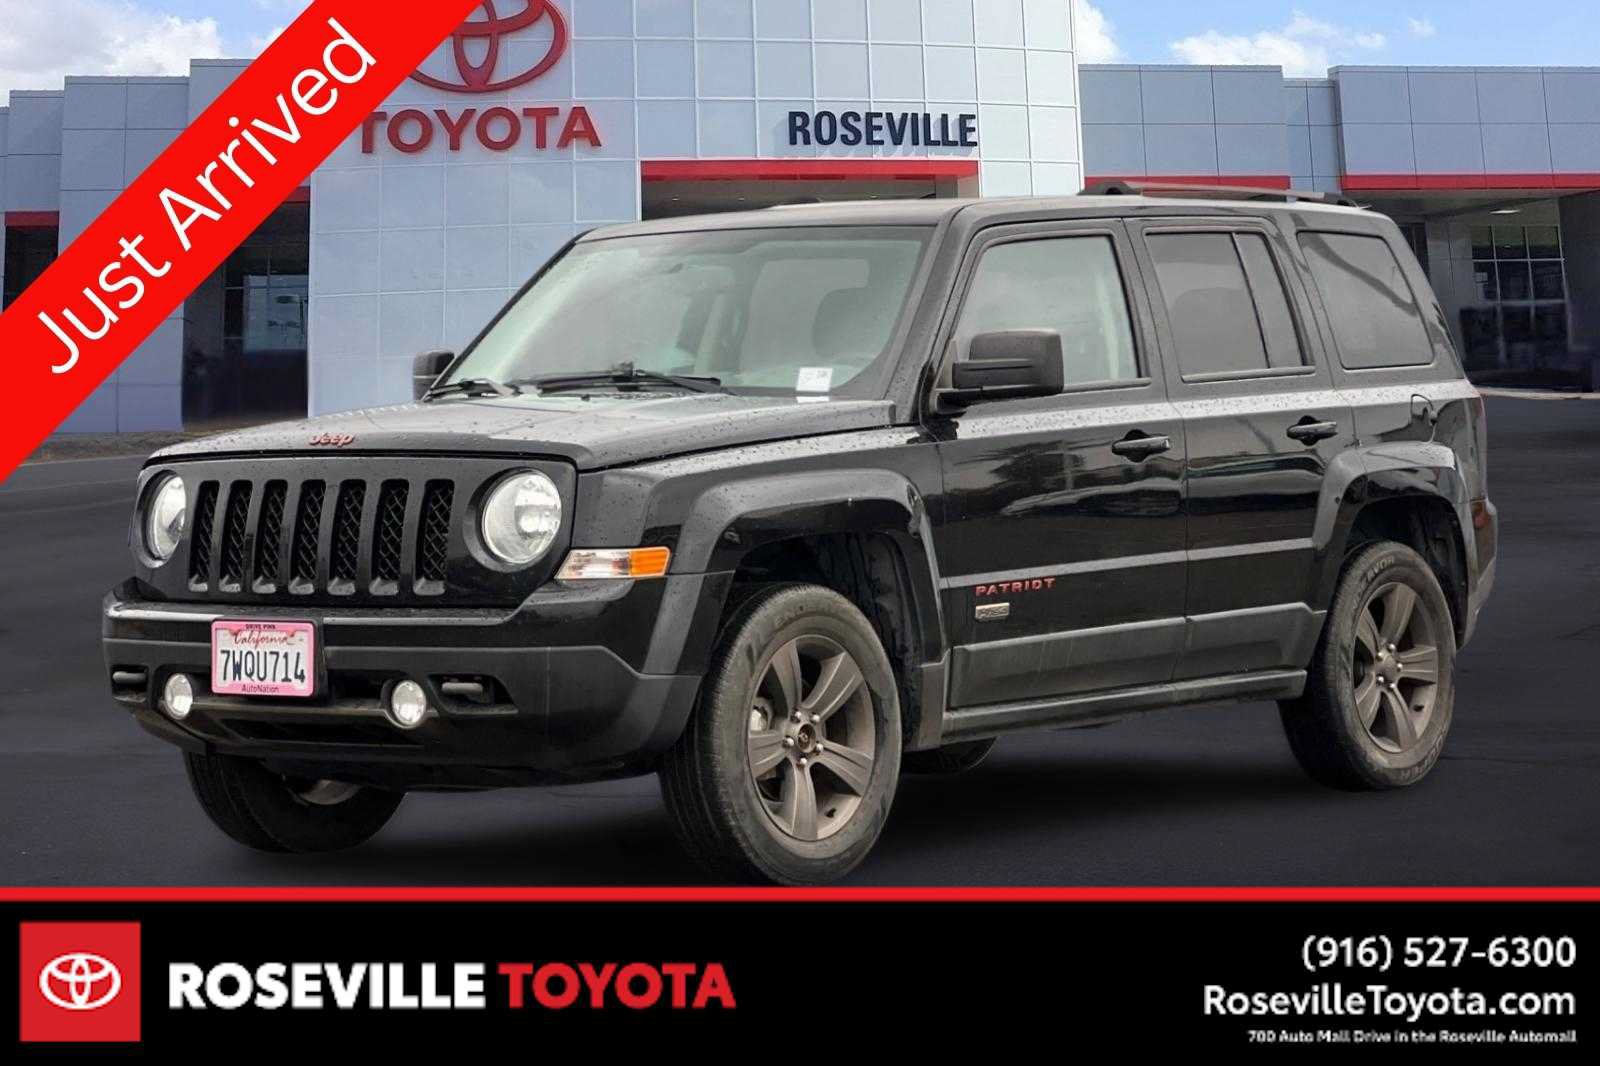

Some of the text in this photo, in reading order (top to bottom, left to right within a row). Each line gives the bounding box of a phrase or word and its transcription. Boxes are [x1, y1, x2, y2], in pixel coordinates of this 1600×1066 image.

[360, 106, 602, 154] TOYOTA
[788, 110, 978, 147] ROSEVILLE
[308, 432, 354, 448] Jeep
[975, 577, 1056, 597] PATRIOT
[234, 629, 288, 649] California
[220, 650, 306, 683] 7WQU714
[241, 684, 280, 694] AutoNation
